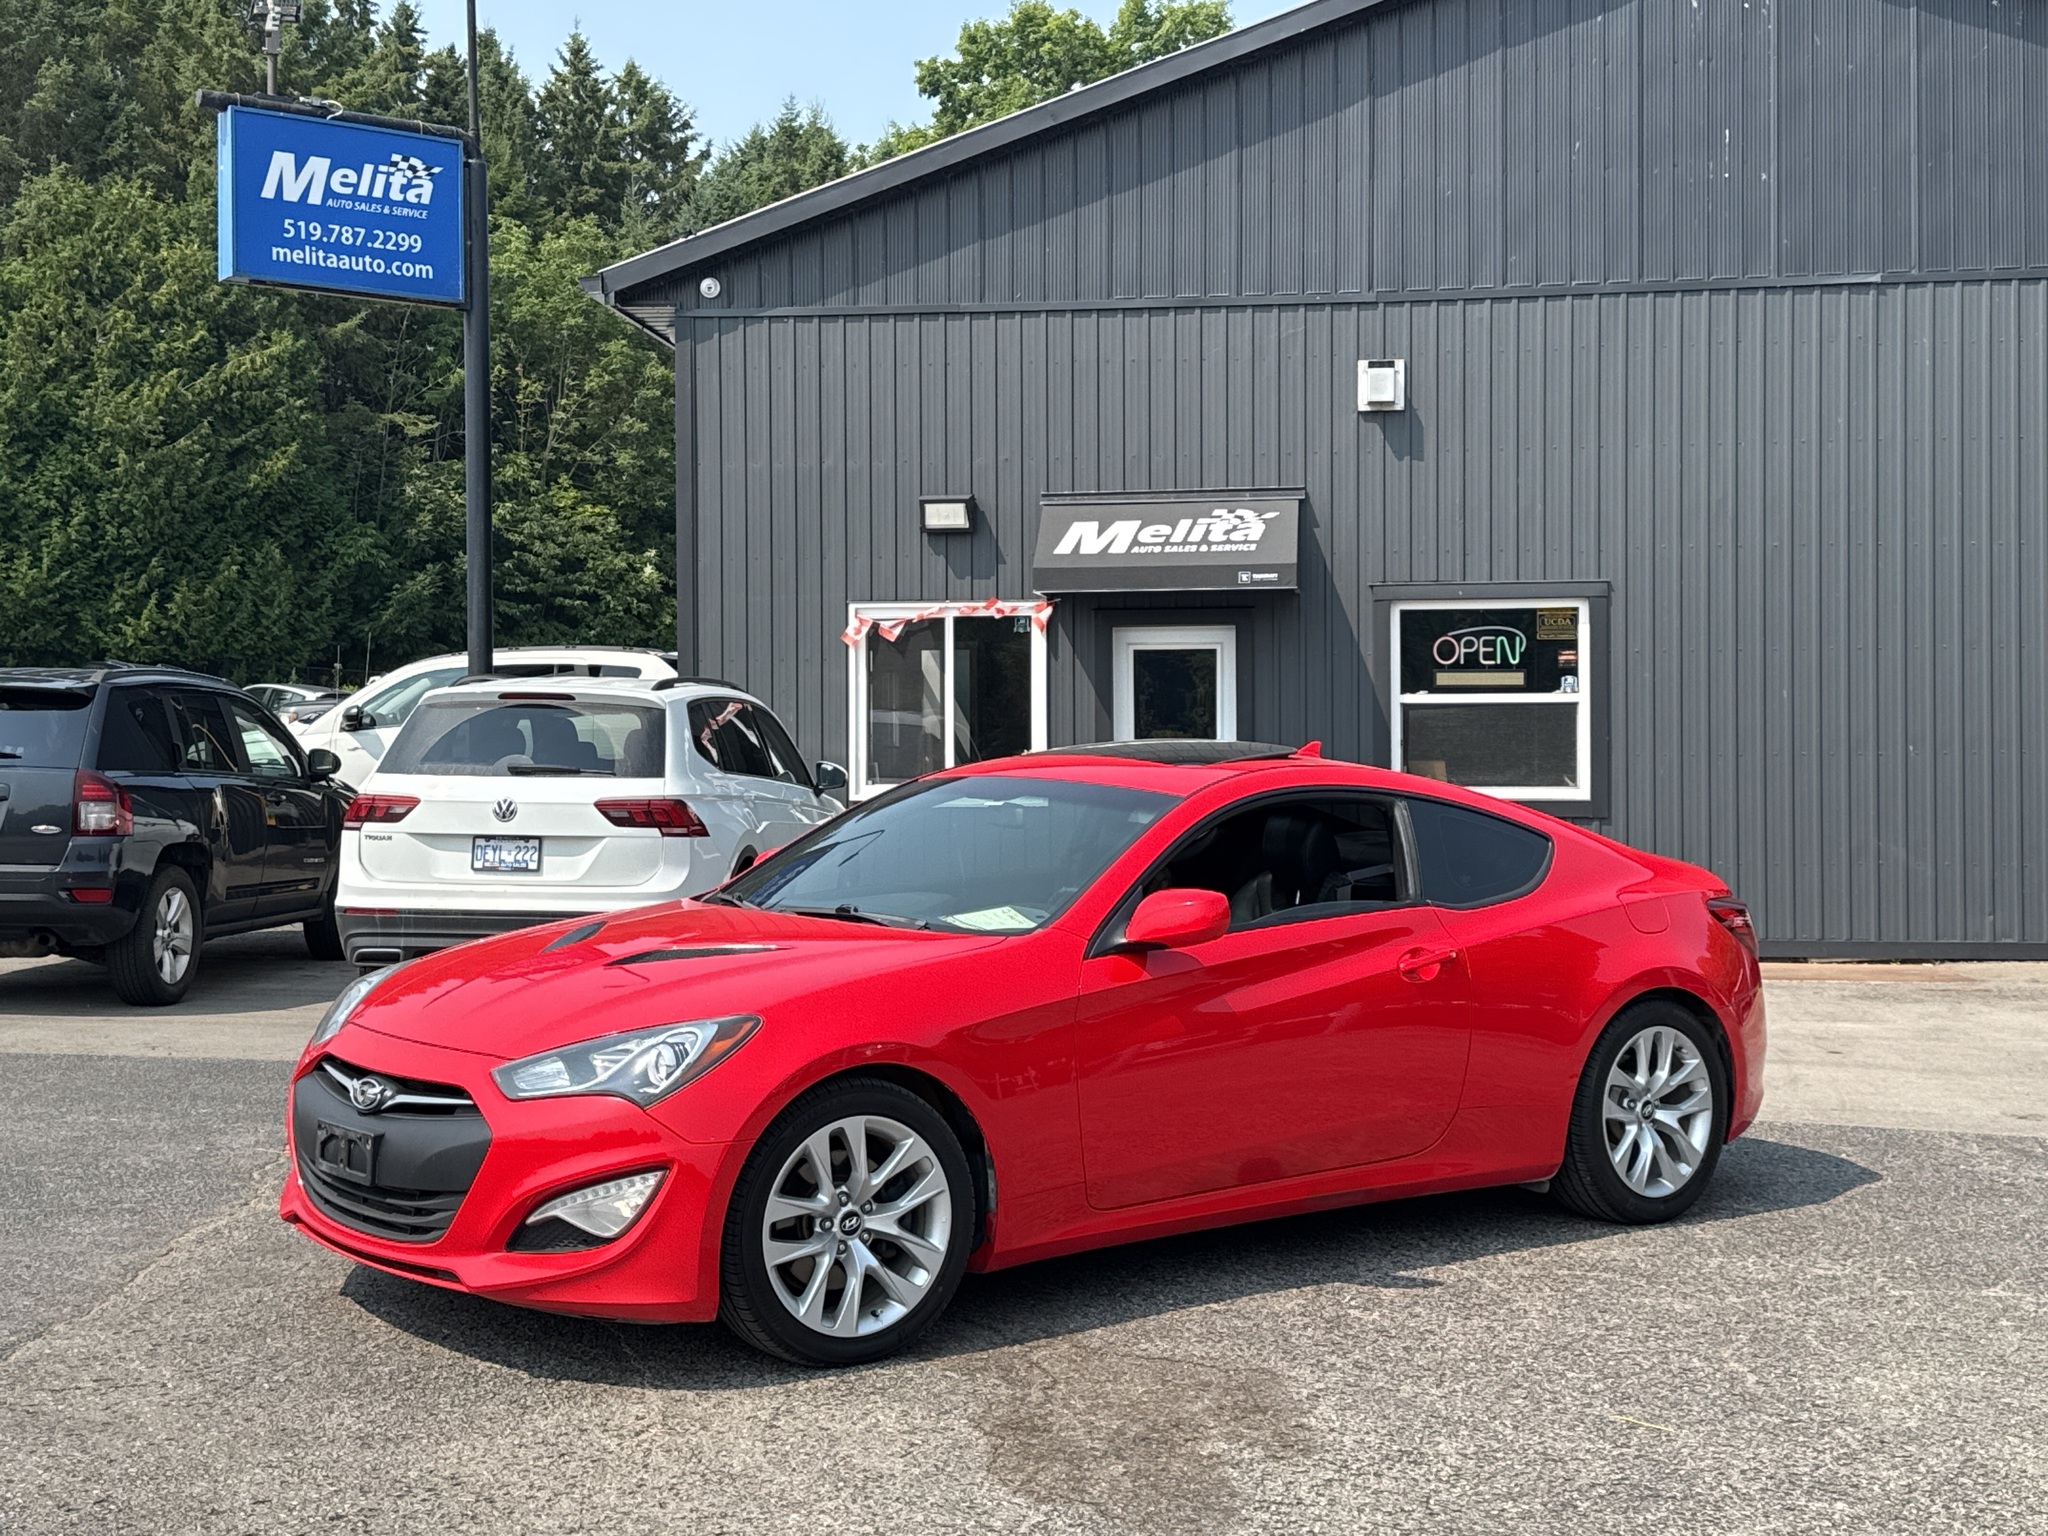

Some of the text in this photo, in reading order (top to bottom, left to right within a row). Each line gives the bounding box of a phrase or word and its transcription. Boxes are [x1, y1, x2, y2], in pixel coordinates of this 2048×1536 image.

[260, 151, 434, 206] Melita
[326, 198, 429, 219] AUTO SALES & SERVICE
[283, 218, 422, 253] 519.787.2299
[271, 245, 434, 280] melitaauto.com
[1053, 516, 1266, 555] Melita
[1130, 545, 1162, 554] AUTO
[1164, 544, 1198, 553] SALES
[1210, 543, 1257, 552] SERVICE
[1544, 618, 1572, 626] UCDA
[1433, 635, 1520, 665] OPEN
